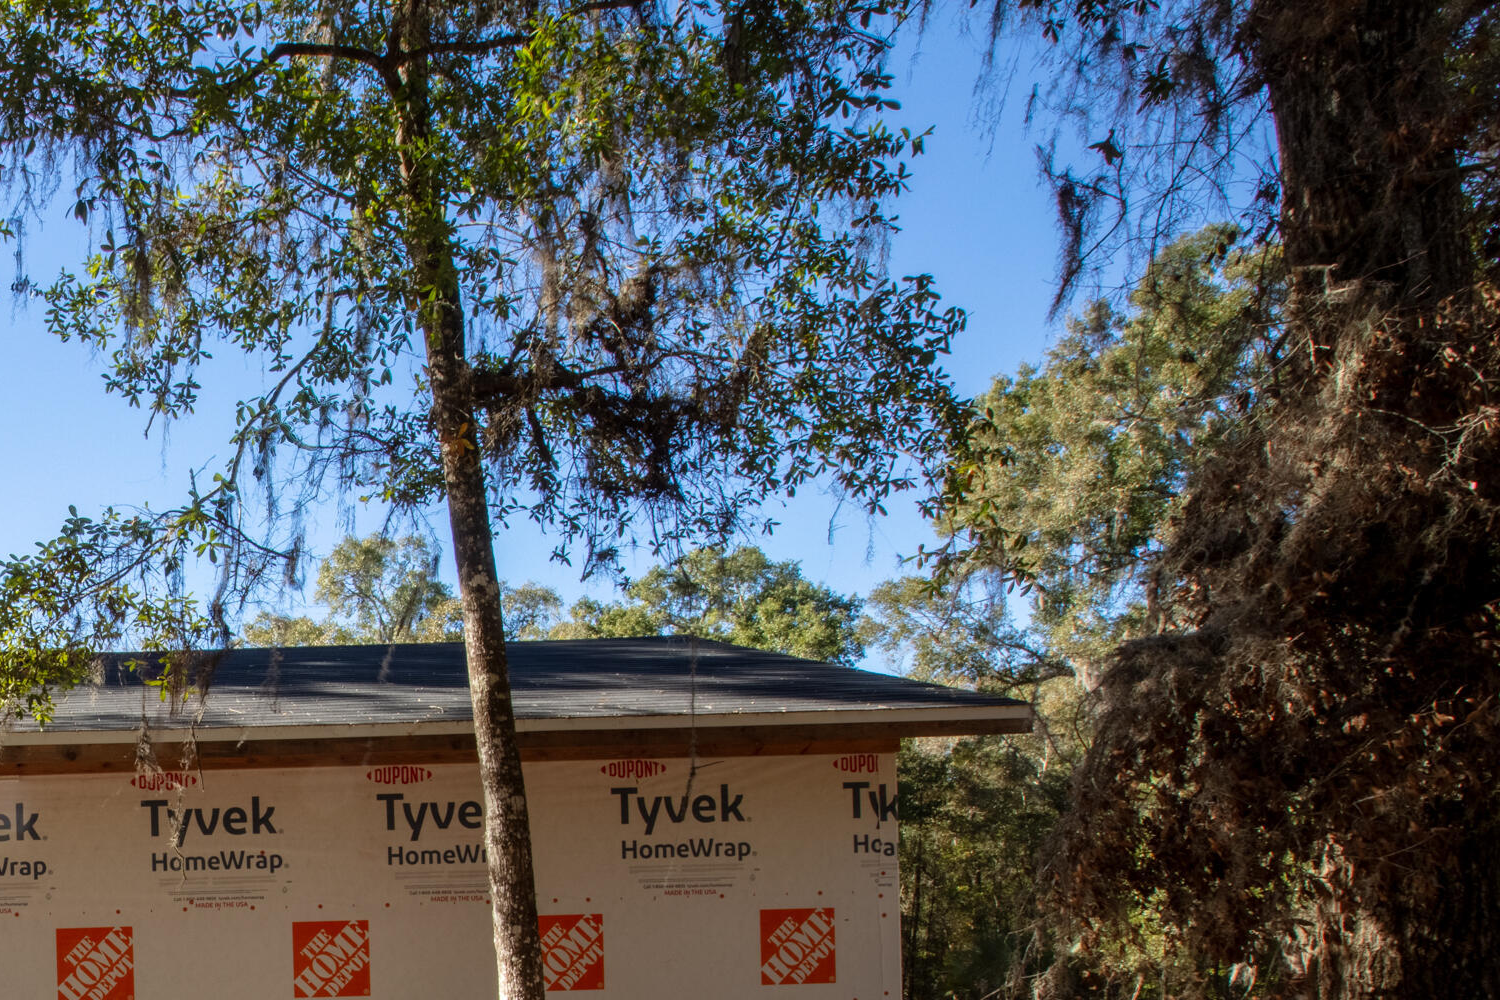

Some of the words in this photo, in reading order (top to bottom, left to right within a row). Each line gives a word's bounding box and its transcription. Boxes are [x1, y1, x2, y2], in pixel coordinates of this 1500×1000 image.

[374, 766, 425, 785] DUPONT
[609, 760, 659, 779] DUPONT
[841, 755, 878, 772] DUPO
[139, 772, 189, 791] DUPONT
[140, 796, 277, 848] Tyvek
[376, 793, 483, 841] Tyve
[610, 784, 745, 835] Tyvek
[152, 851, 283, 874] HomeWrap
[387, 844, 487, 865] HomeWr
[621, 838, 751, 861] HomeWrap
[300, 929, 332, 959] THE
[767, 916, 799, 946] THE
[64, 935, 96, 966] THE
[294, 920, 369, 998] HOME
[761, 908, 836, 985] HOME
[790, 936, 836, 985] DEPOT
[324, 948, 371, 997] DEPOT
[558, 943, 604, 991] DEPOT
